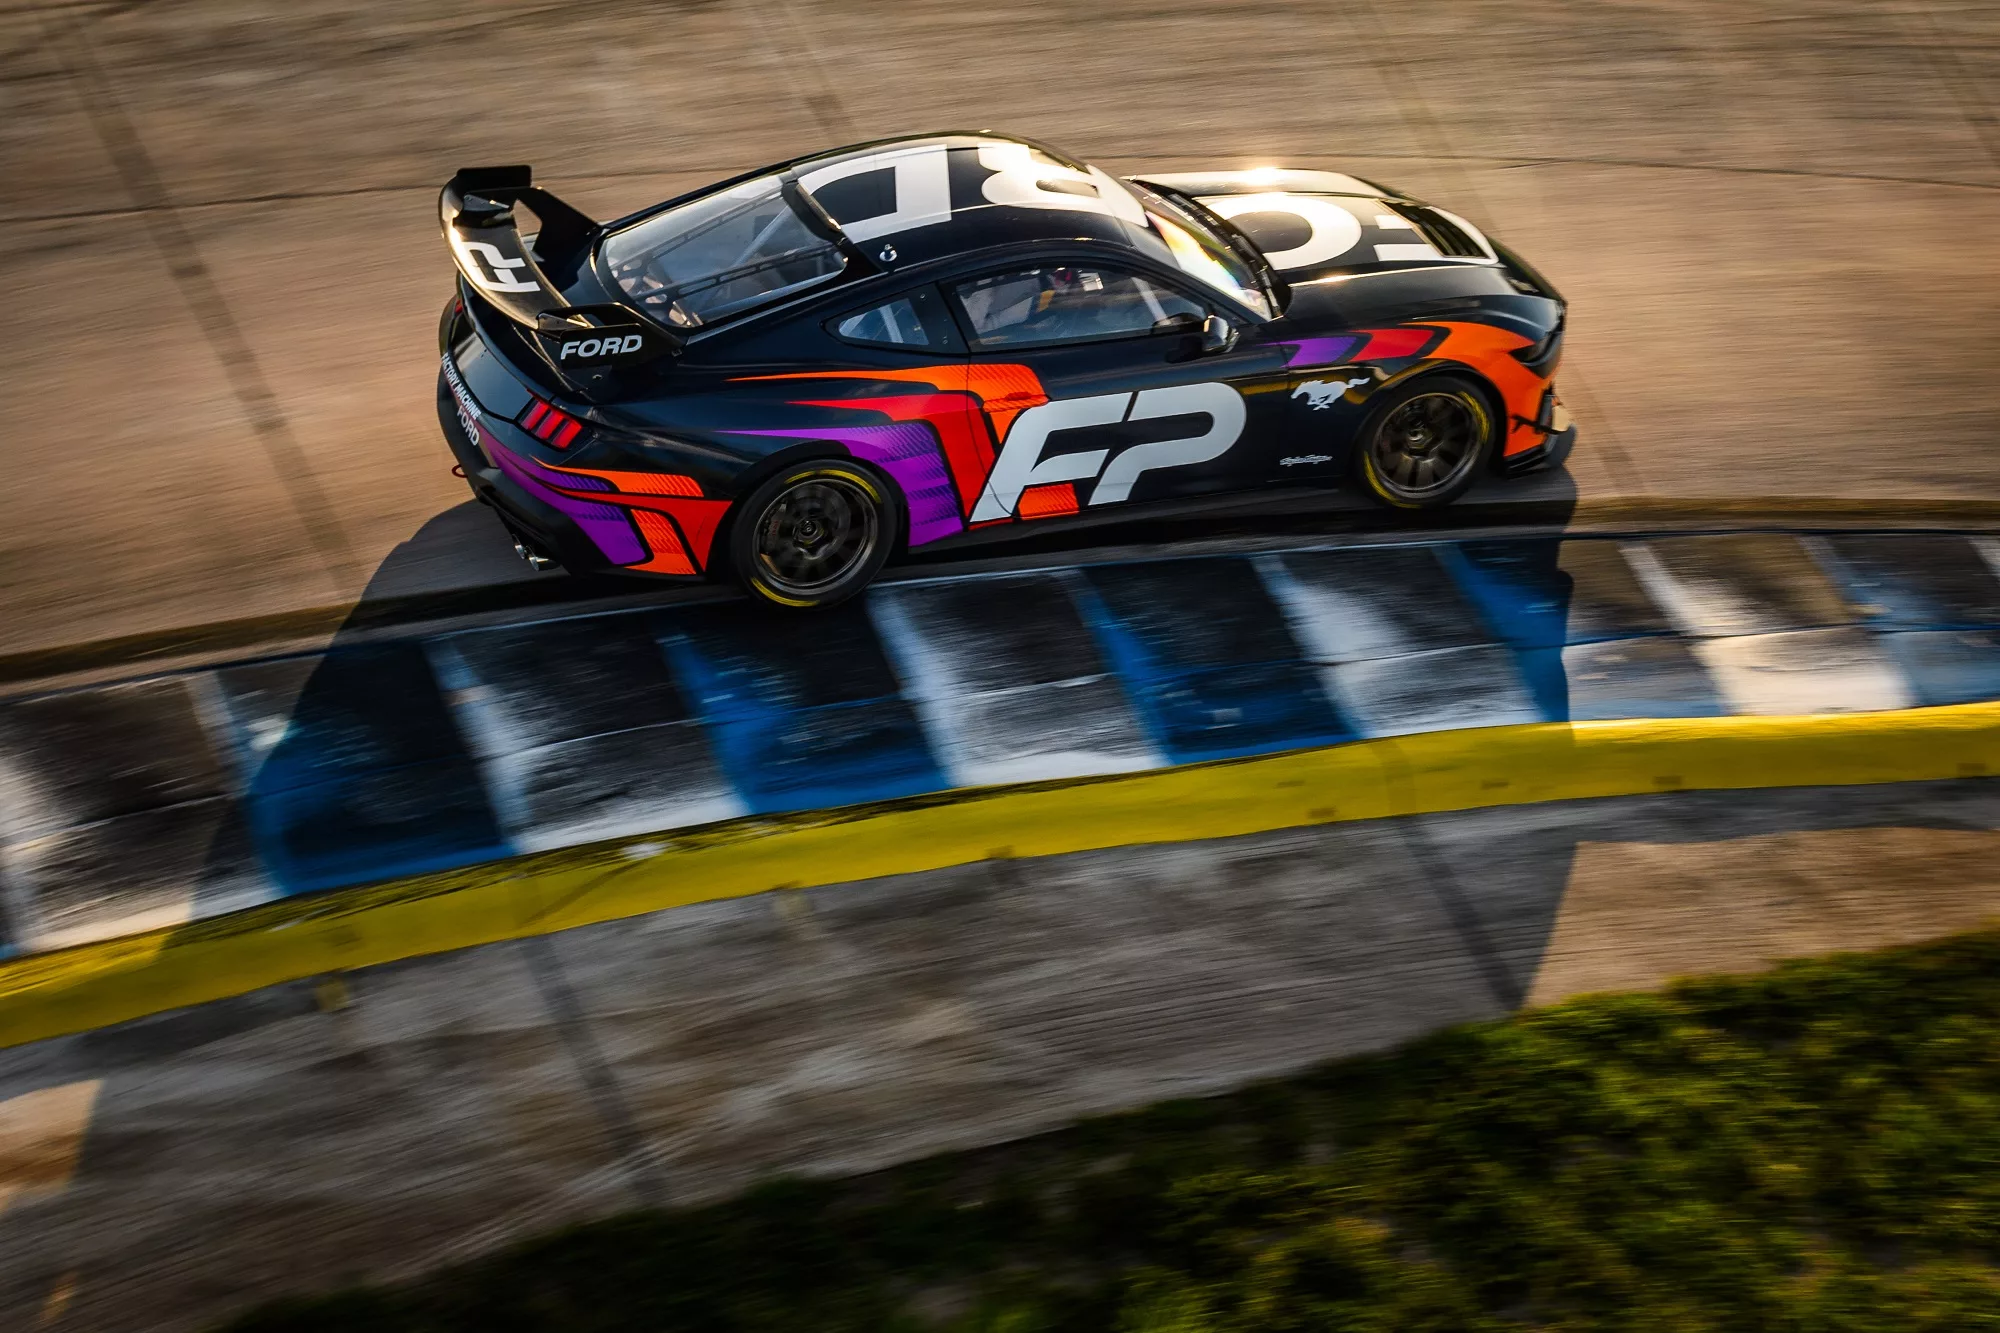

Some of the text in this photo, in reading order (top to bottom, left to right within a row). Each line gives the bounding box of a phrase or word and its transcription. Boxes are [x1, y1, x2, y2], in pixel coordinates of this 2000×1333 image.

[560, 335, 643, 360] FORD
[441, 352, 482, 421] FACTORY MACHINE
[456, 405, 480, 446] FORD
[969, 381, 1247, 523] FP
